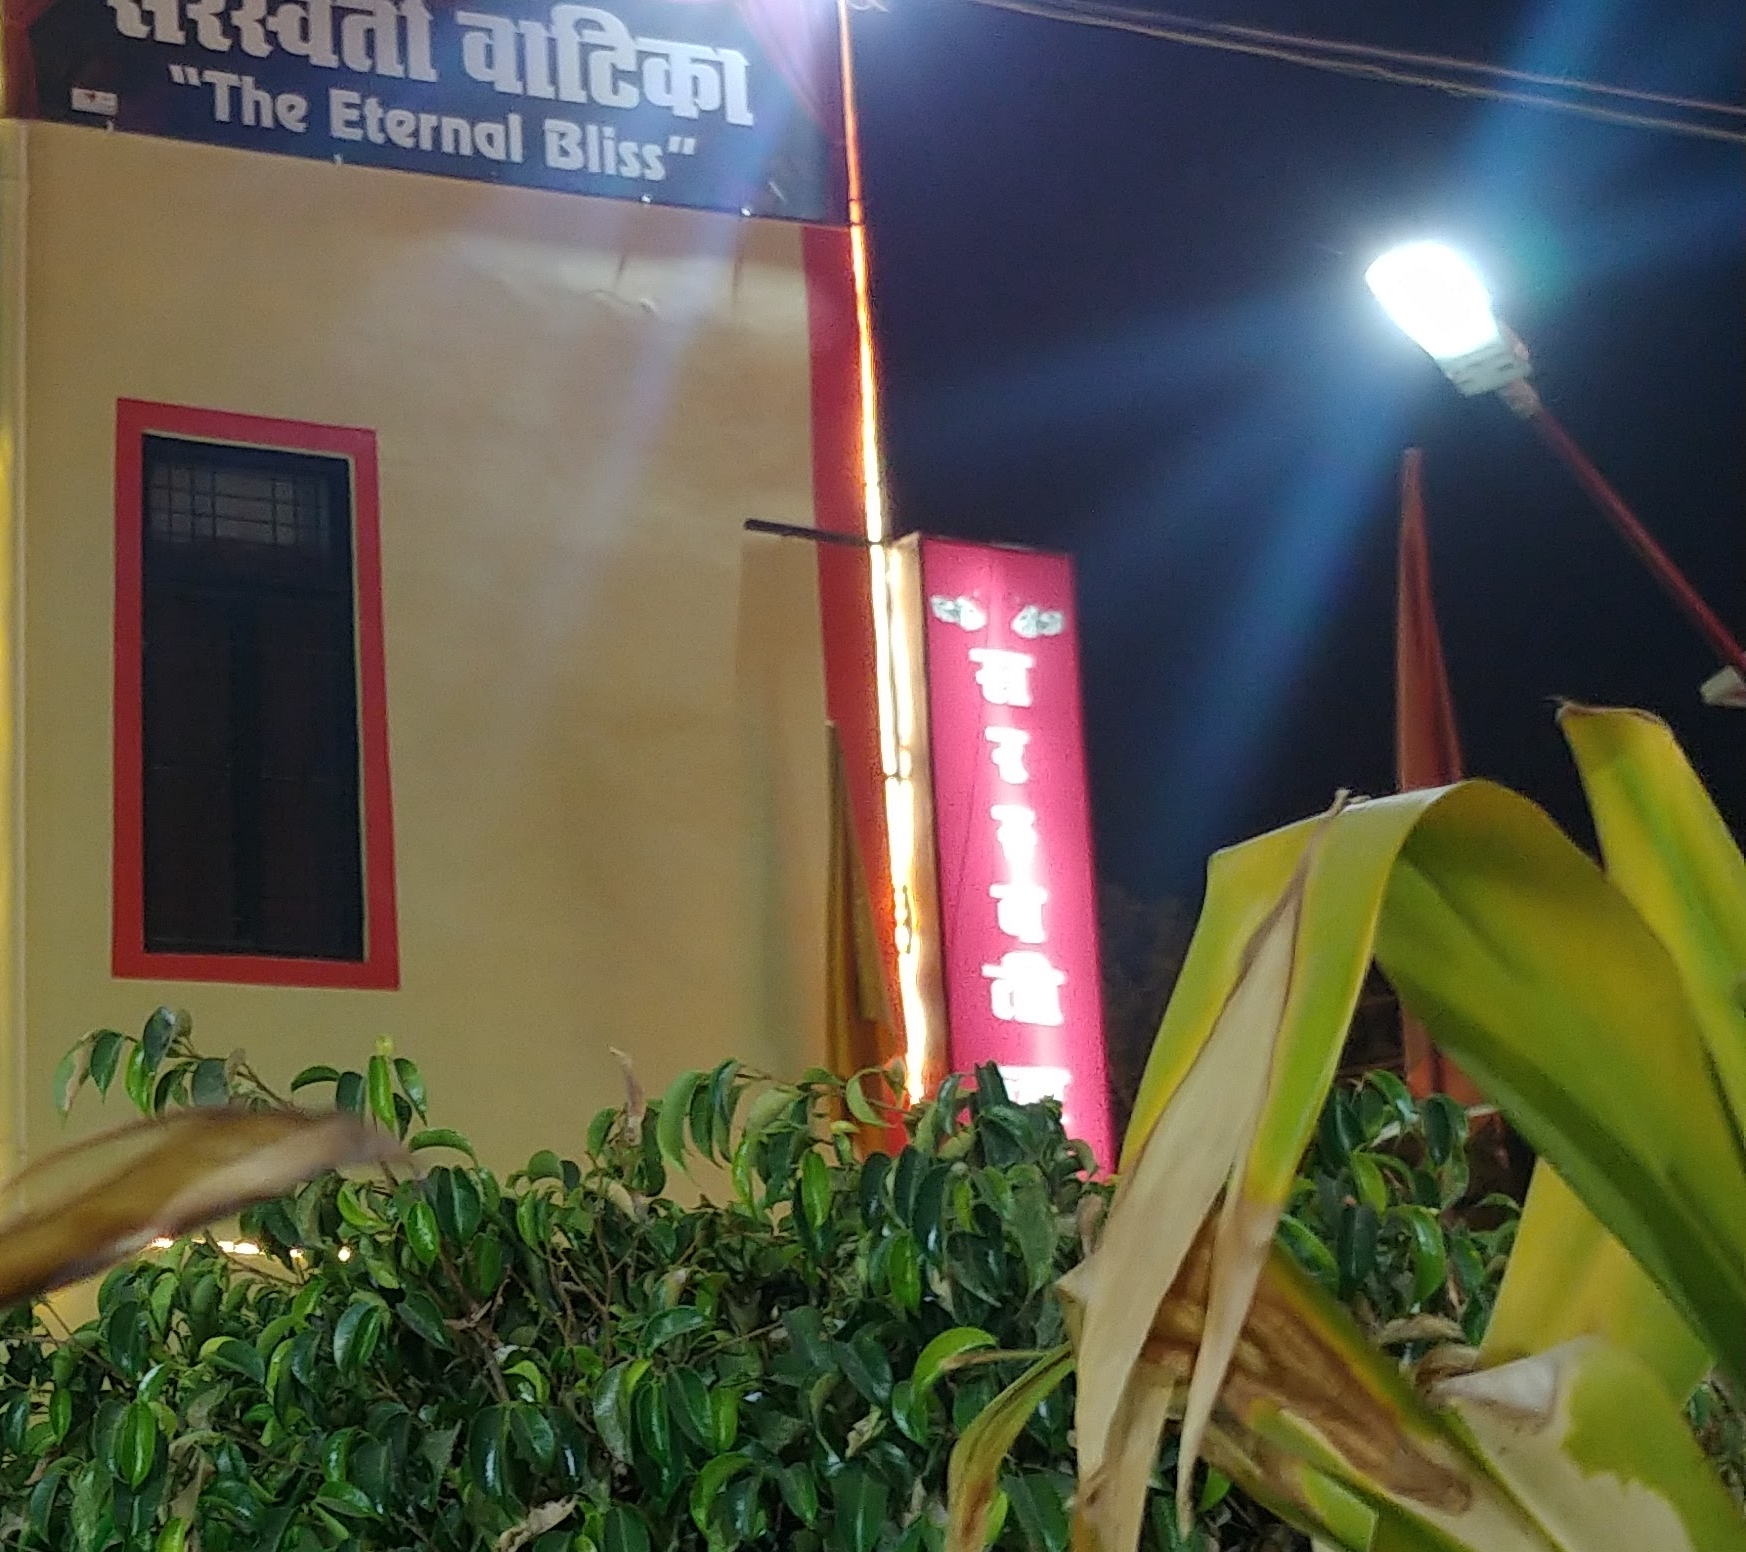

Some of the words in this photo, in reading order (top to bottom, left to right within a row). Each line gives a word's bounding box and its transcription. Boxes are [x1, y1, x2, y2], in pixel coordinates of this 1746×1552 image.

[168, 62, 308, 135] "The
[328, 88, 523, 164] Eternal
[543, 118, 698, 181] Bliss"
[458, 3, 755, 126] वाटिका
